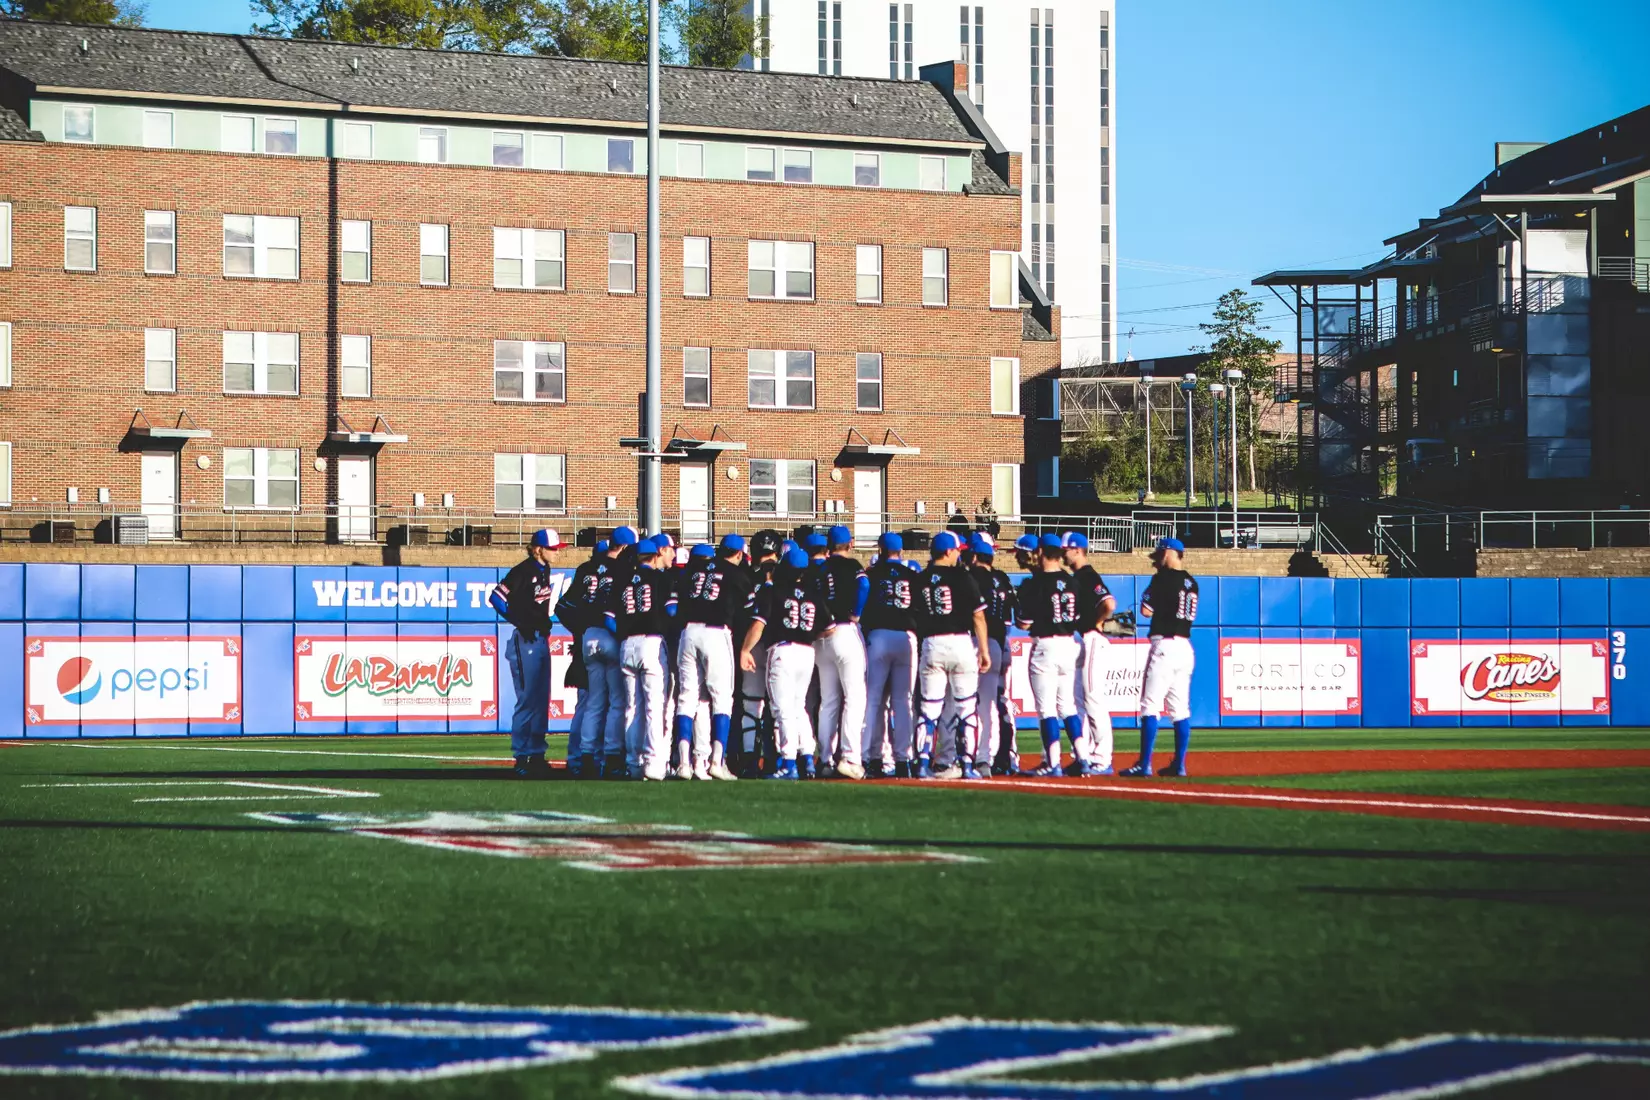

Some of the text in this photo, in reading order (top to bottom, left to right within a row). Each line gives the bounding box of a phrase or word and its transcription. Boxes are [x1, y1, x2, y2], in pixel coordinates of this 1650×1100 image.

[312, 580, 457, 608] WELCOME
[690, 572, 723, 601] 35
[922, 585, 953, 615] 19
[783, 598, 816, 631] 39
[1051, 592, 1075, 624] 13
[1176, 590, 1198, 621] 10
[112, 662, 208, 699] pepsi
[1232, 663, 1346, 678] PORTICO
[1463, 653, 1560, 701] Cane's
